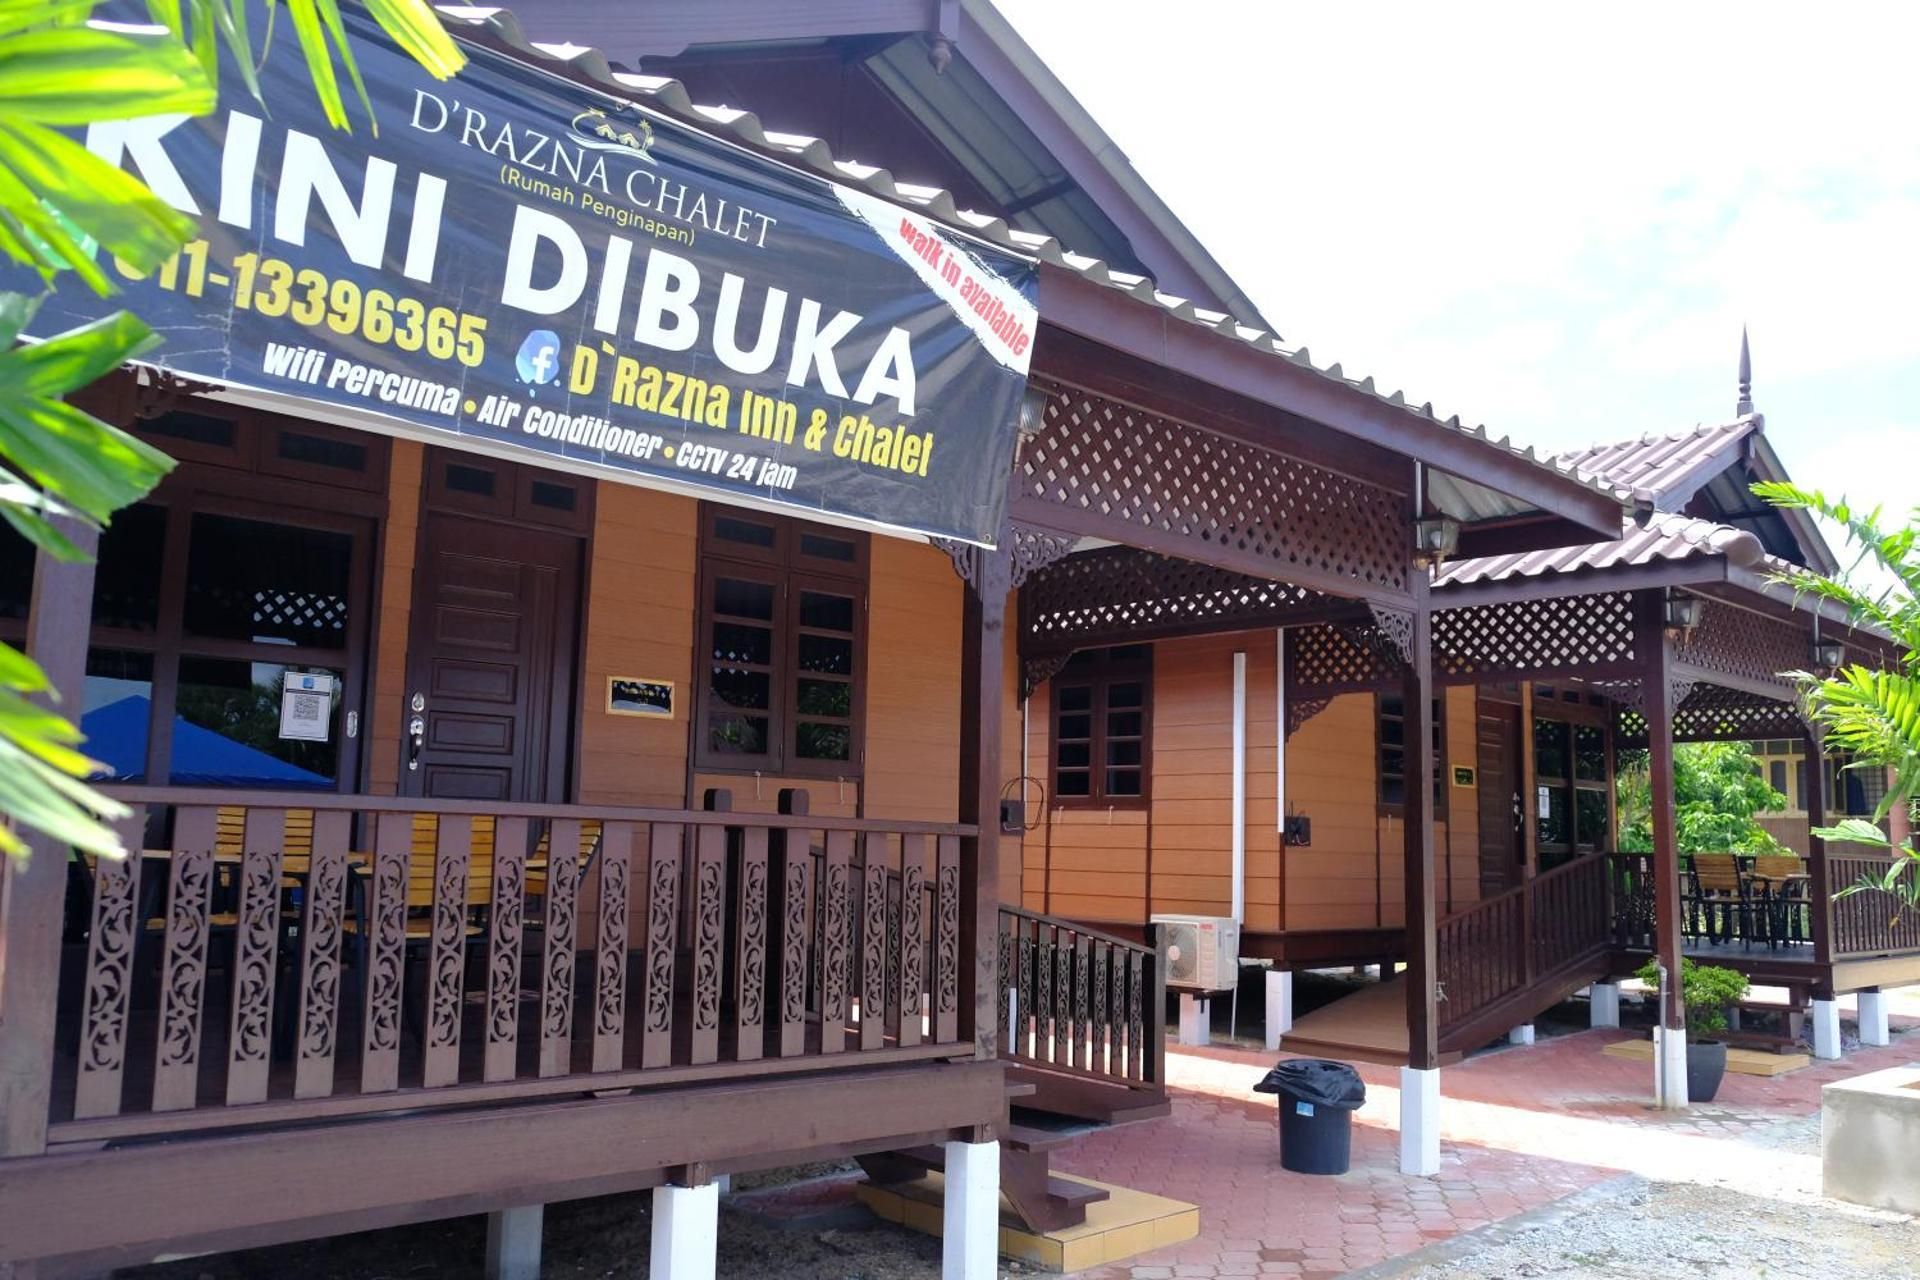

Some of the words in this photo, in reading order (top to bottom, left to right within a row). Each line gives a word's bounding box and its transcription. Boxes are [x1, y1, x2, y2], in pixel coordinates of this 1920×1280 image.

[410, 89, 612, 195] D'RAZNA
[626, 169, 778, 250] CHALET
[500, 164, 575, 207] (Rumah
[580, 192, 695, 248] Penginapan)
[86, 109, 448, 285] KINI
[501, 204, 917, 418] DIBUKA
[899, 217, 944, 272] walk
[940, 252, 963, 289] in
[958, 274, 1030, 357] available
[262, 342, 328, 385] Wifi
[326, 357, 462, 417] Percuma
[476, 394, 520, 429] Air
[523, 404, 665, 460] Conditioner
[675, 441, 725, 475] CCTV
[726, 452, 760, 481] 24
[756, 457, 799, 491] jam
[738, 388, 798, 446] Inn
[803, 407, 829, 453] &
[831, 414, 934, 477] Chalet
